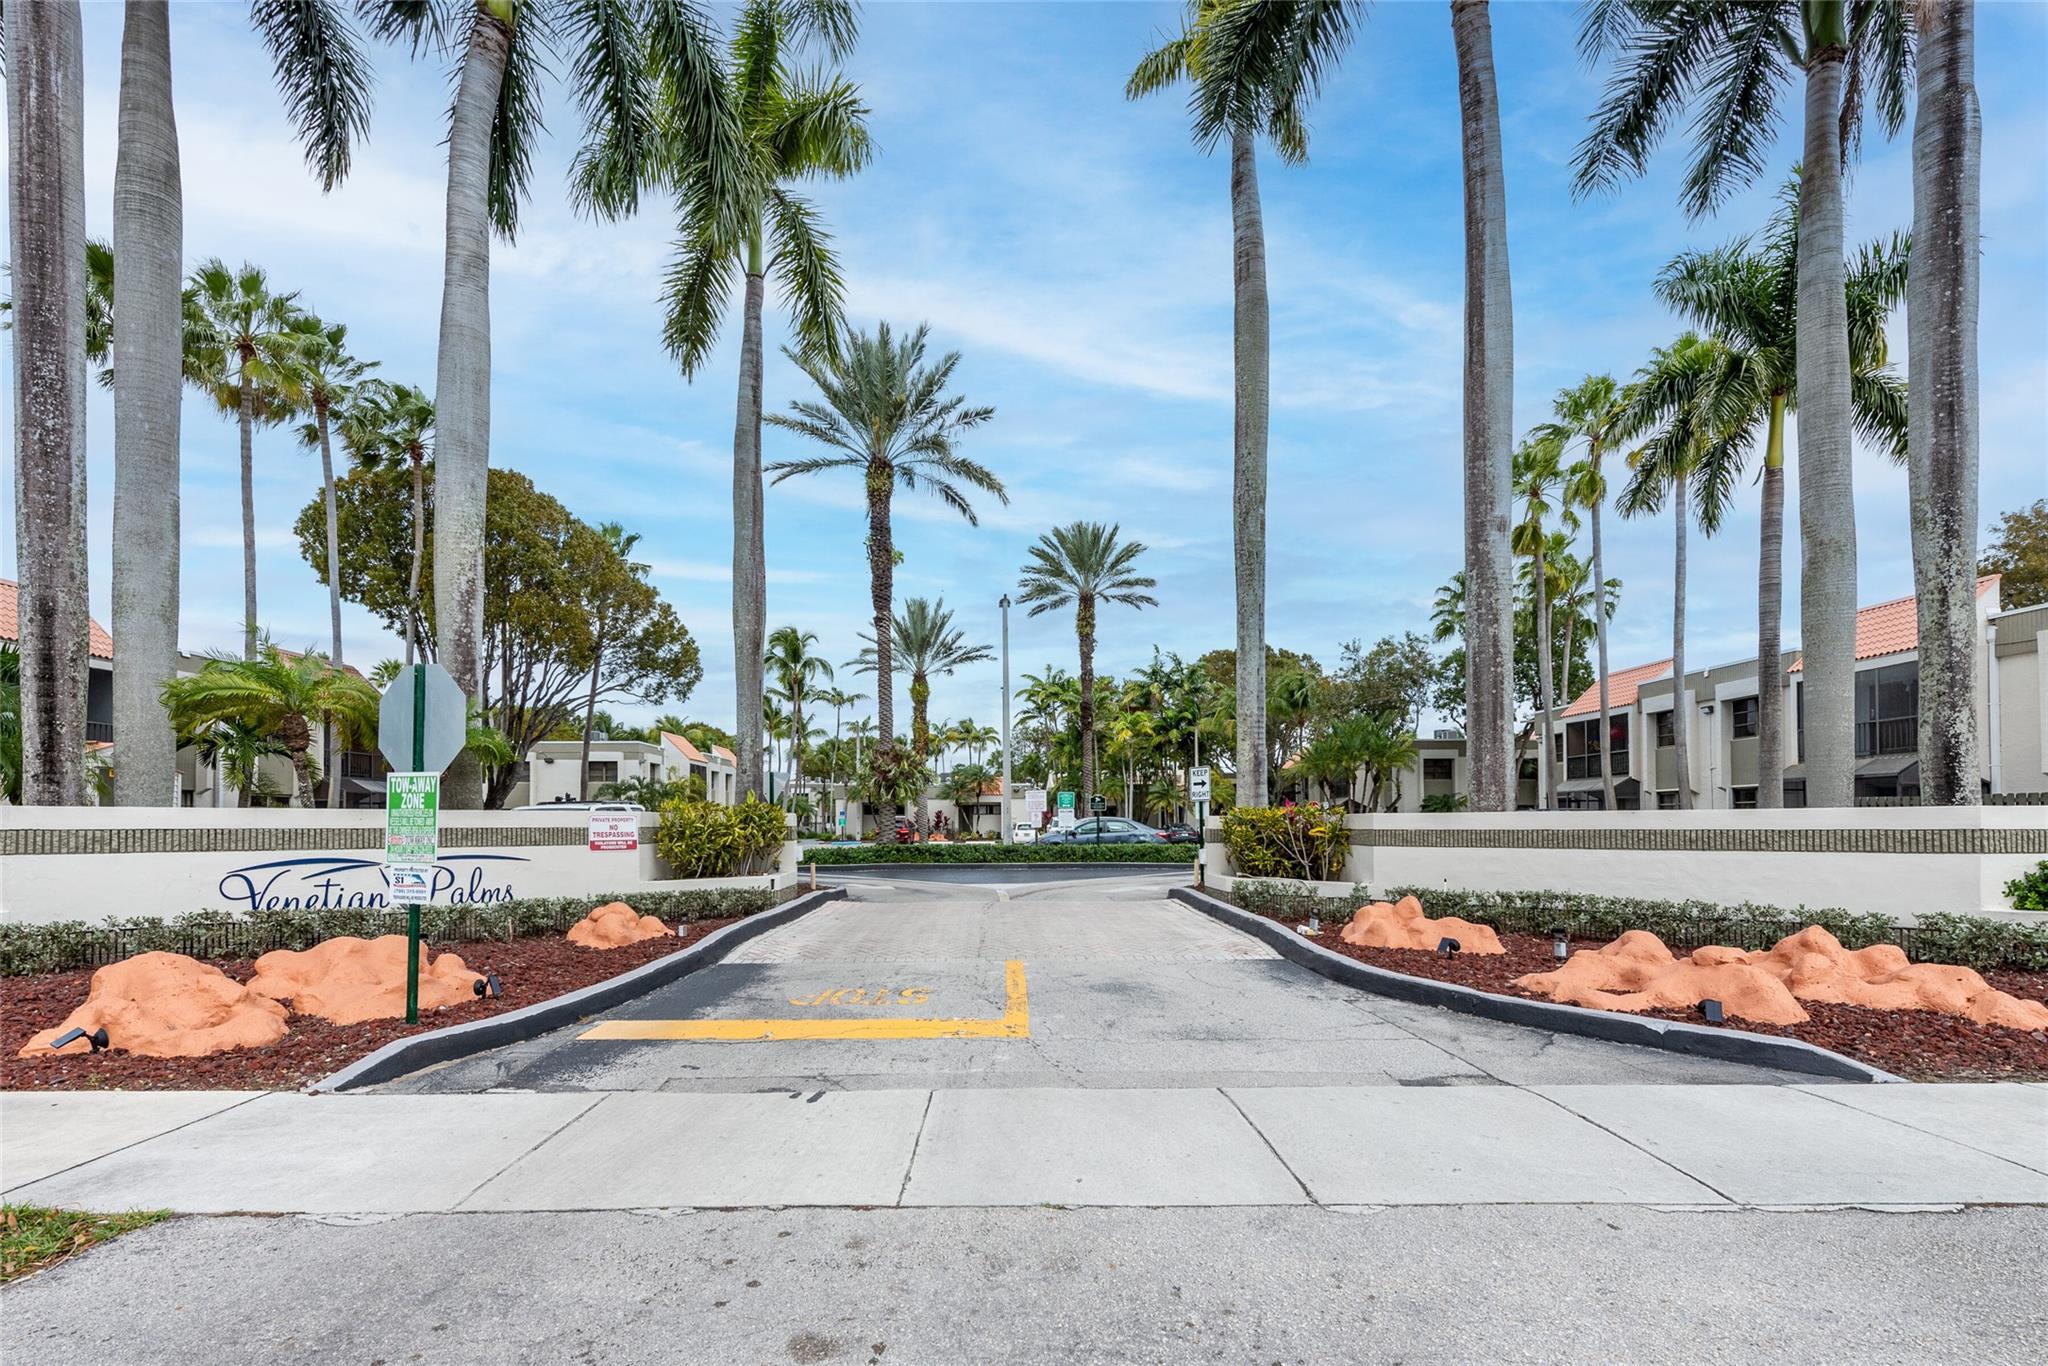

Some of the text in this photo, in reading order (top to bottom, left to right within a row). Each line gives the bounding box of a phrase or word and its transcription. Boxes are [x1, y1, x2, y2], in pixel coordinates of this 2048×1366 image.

[1192, 769, 1208, 777] KEEP
[390, 777, 437, 793] TOW-AWAY
[401, 793, 425, 809] ZONE
[1192, 790, 1209, 798] RIGHT
[219, 865, 513, 911] Venetian Palms
